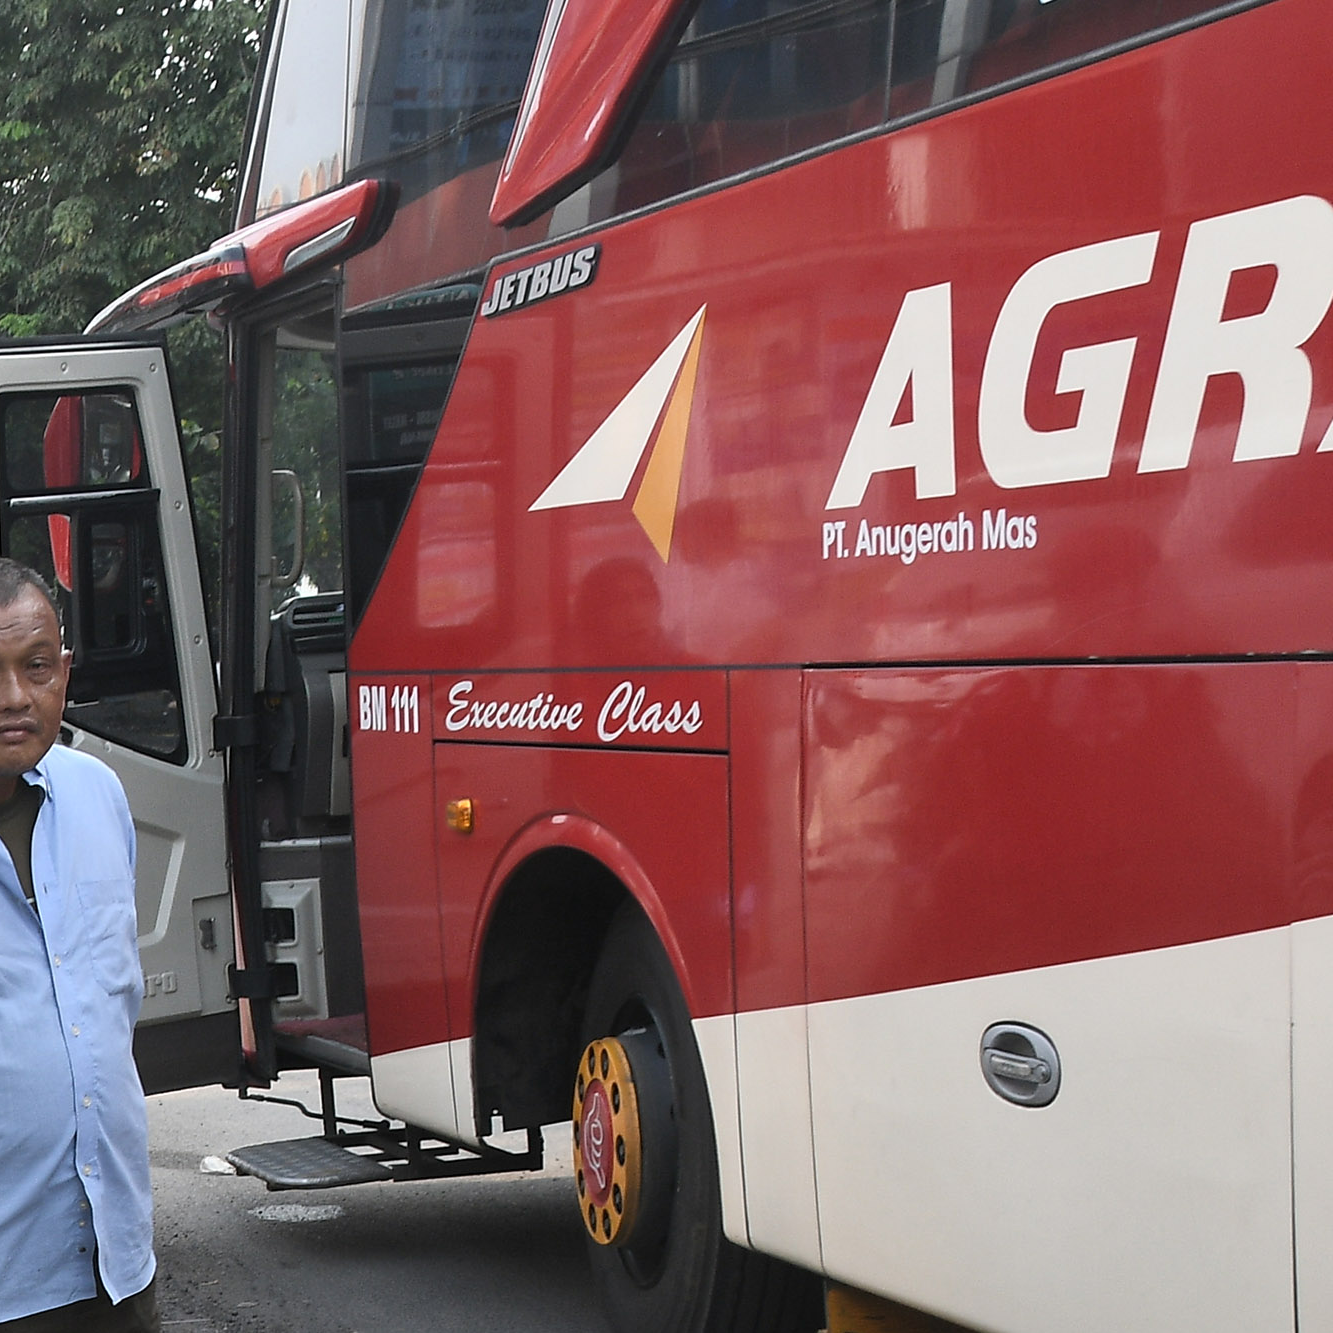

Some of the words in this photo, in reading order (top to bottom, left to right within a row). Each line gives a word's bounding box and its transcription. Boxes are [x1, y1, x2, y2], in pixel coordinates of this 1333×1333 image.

[482, 244, 598, 317] JETBUS
[824, 194, 1333, 510] AGR
[822, 520, 849, 560] PT.
[854, 511, 974, 565] Anugerah
[982, 508, 1037, 551] Mas
[359, 685, 387, 732] BM
[391, 685, 420, 733] 111
[445, 680, 584, 732] Executive
[597, 681, 703, 743] Class
